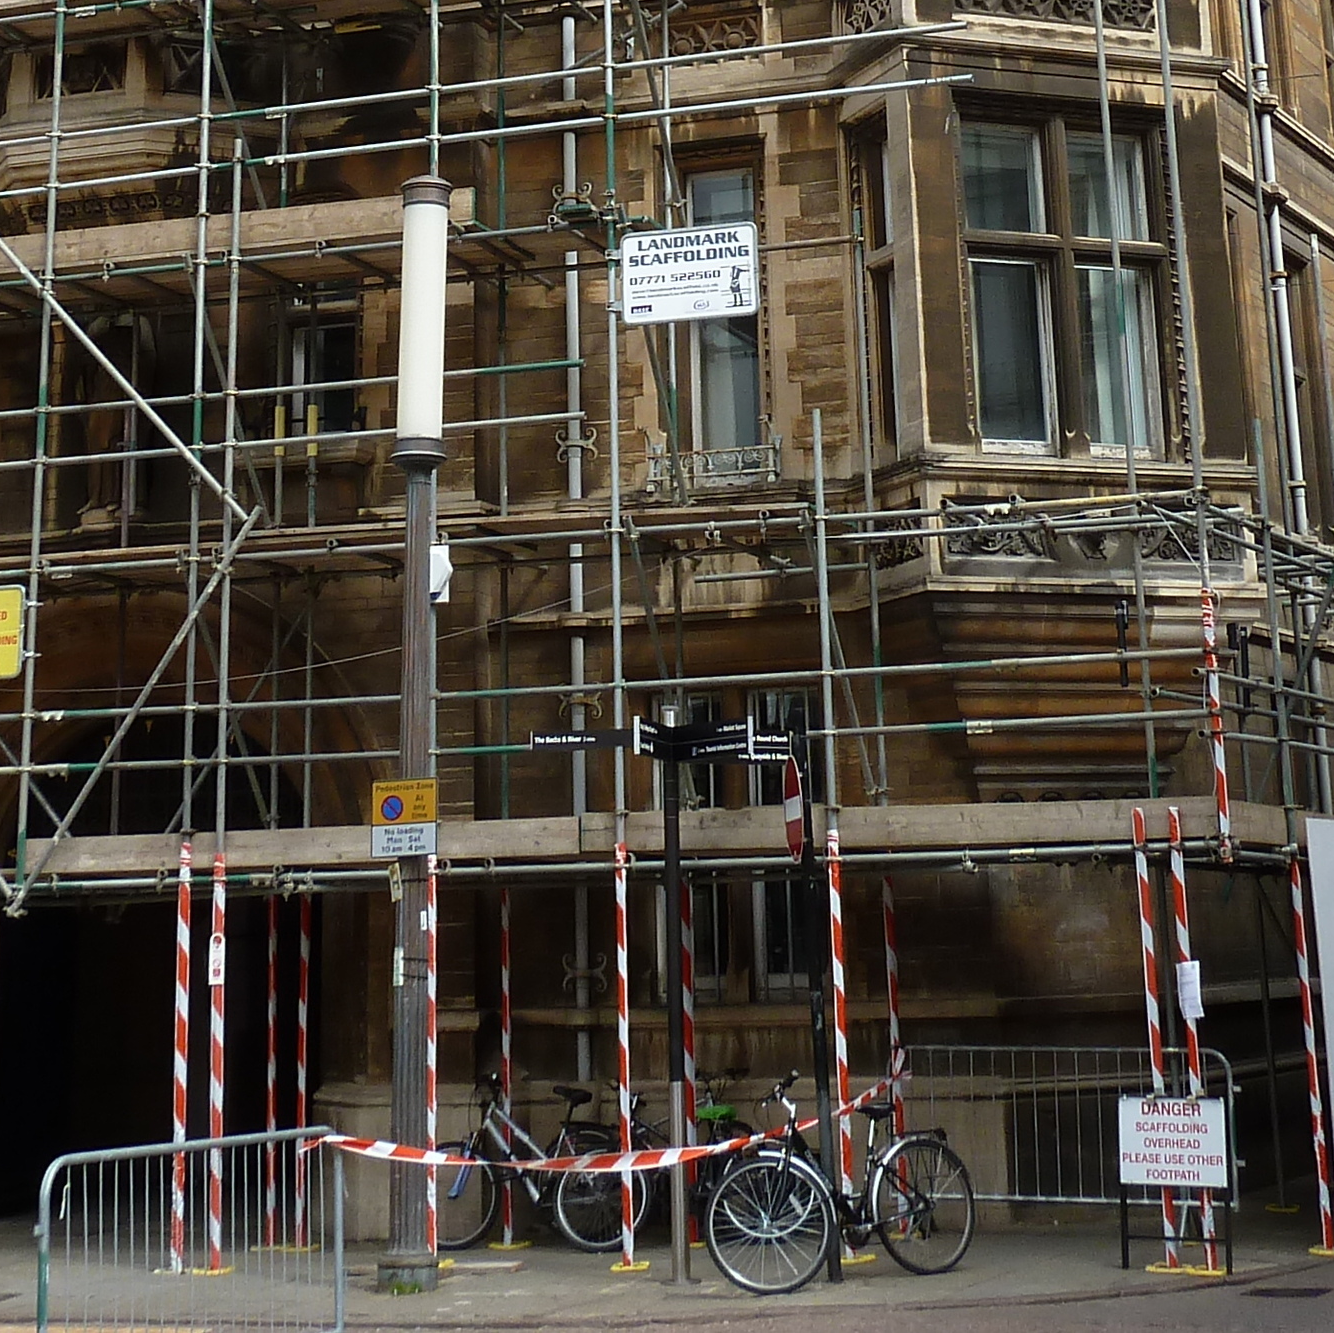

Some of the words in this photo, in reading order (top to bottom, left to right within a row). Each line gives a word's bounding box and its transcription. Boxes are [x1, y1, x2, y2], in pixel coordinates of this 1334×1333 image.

[637, 231, 739, 252] LANDMARK
[628, 245, 750, 267] SCAFFOLDING
[629, 275, 666, 286] 07771
[670, 269, 721, 282] 522560
[416, 782, 433, 790] Zone
[415, 794, 424, 802] At
[384, 828, 395, 836] No
[397, 827, 424, 835] loading
[1141, 1101, 1202, 1117] DANGER
[1135, 1121, 1208, 1134] SCAFFOLDING
[1143, 1137, 1201, 1149] OVERHEAD
[1122, 1152, 1162, 1164] PLEASE
[1164, 1153, 1185, 1165] USE
[1187, 1154, 1224, 1167] OTHER
[1146, 1168, 1201, 1181] FOOTPATH
